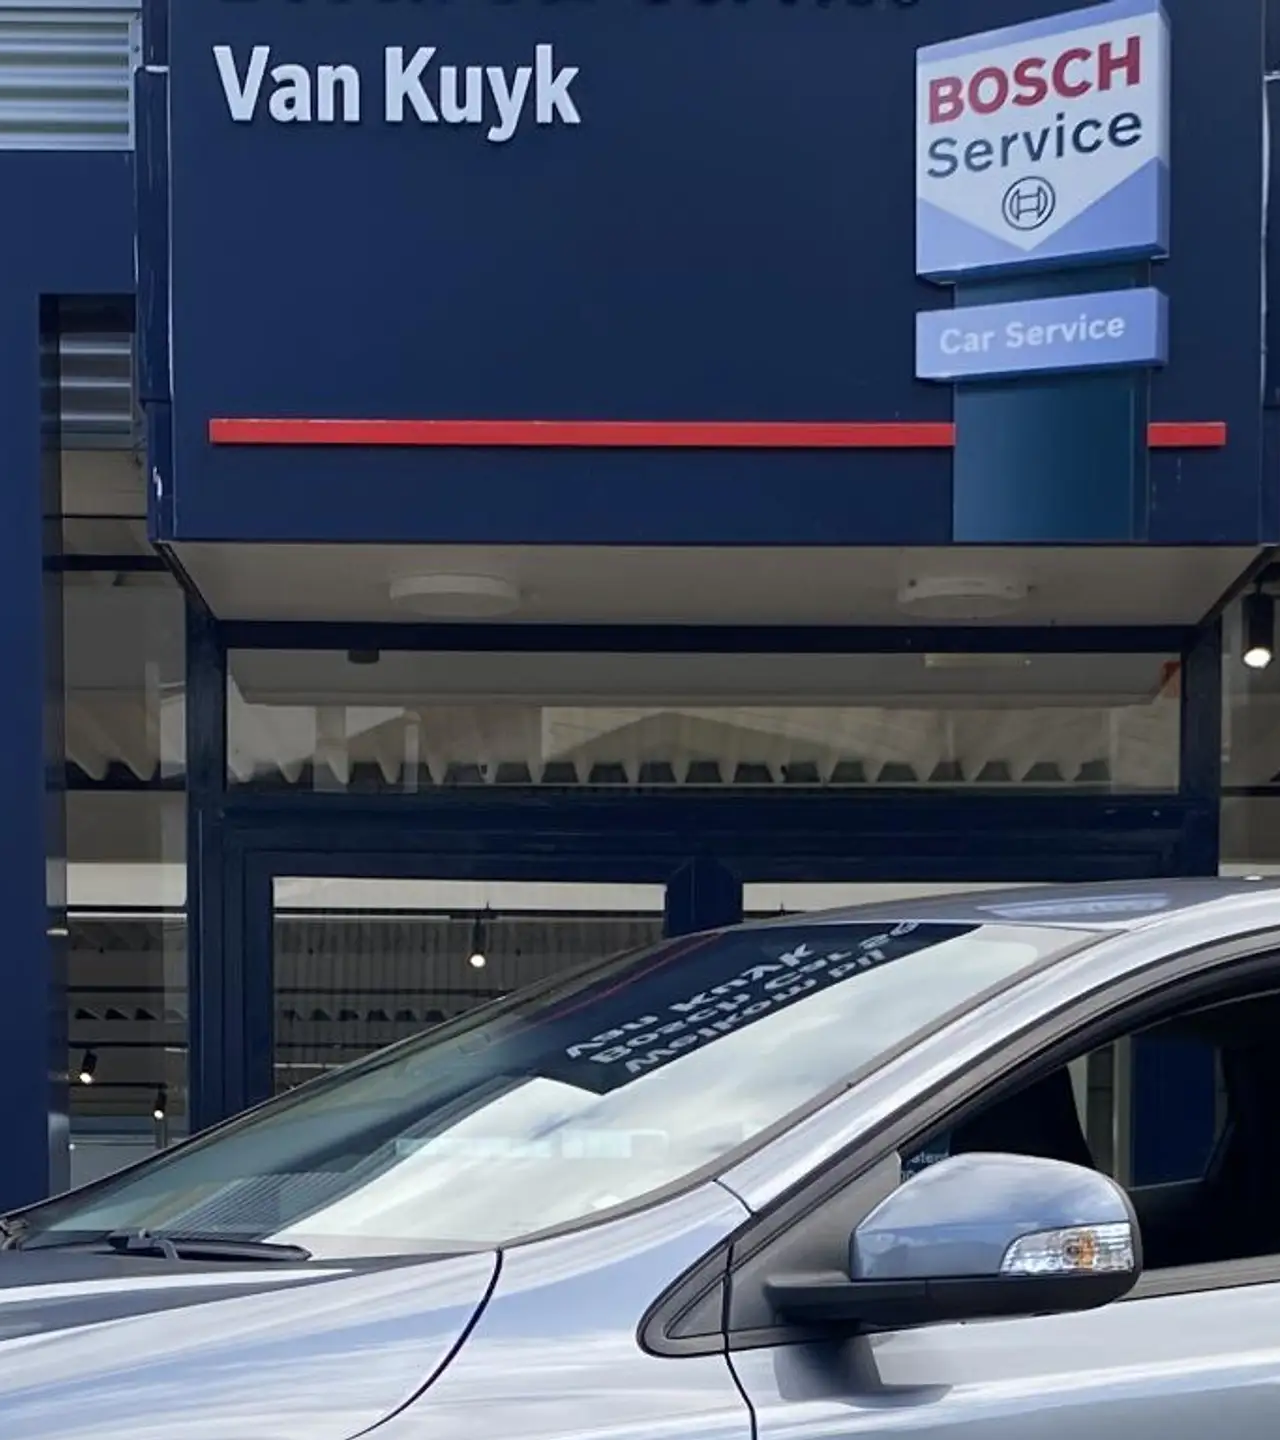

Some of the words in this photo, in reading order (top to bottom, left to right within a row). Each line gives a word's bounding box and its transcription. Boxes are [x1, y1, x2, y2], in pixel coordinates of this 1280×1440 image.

[212, 45, 360, 123] Van
[384, 44, 581, 142] Kuyk
[928, 35, 1141, 125] BOSCH
[926, 111, 1143, 179] Service
[940, 327, 994, 356] Car
[1005, 313, 1125, 349] Service
